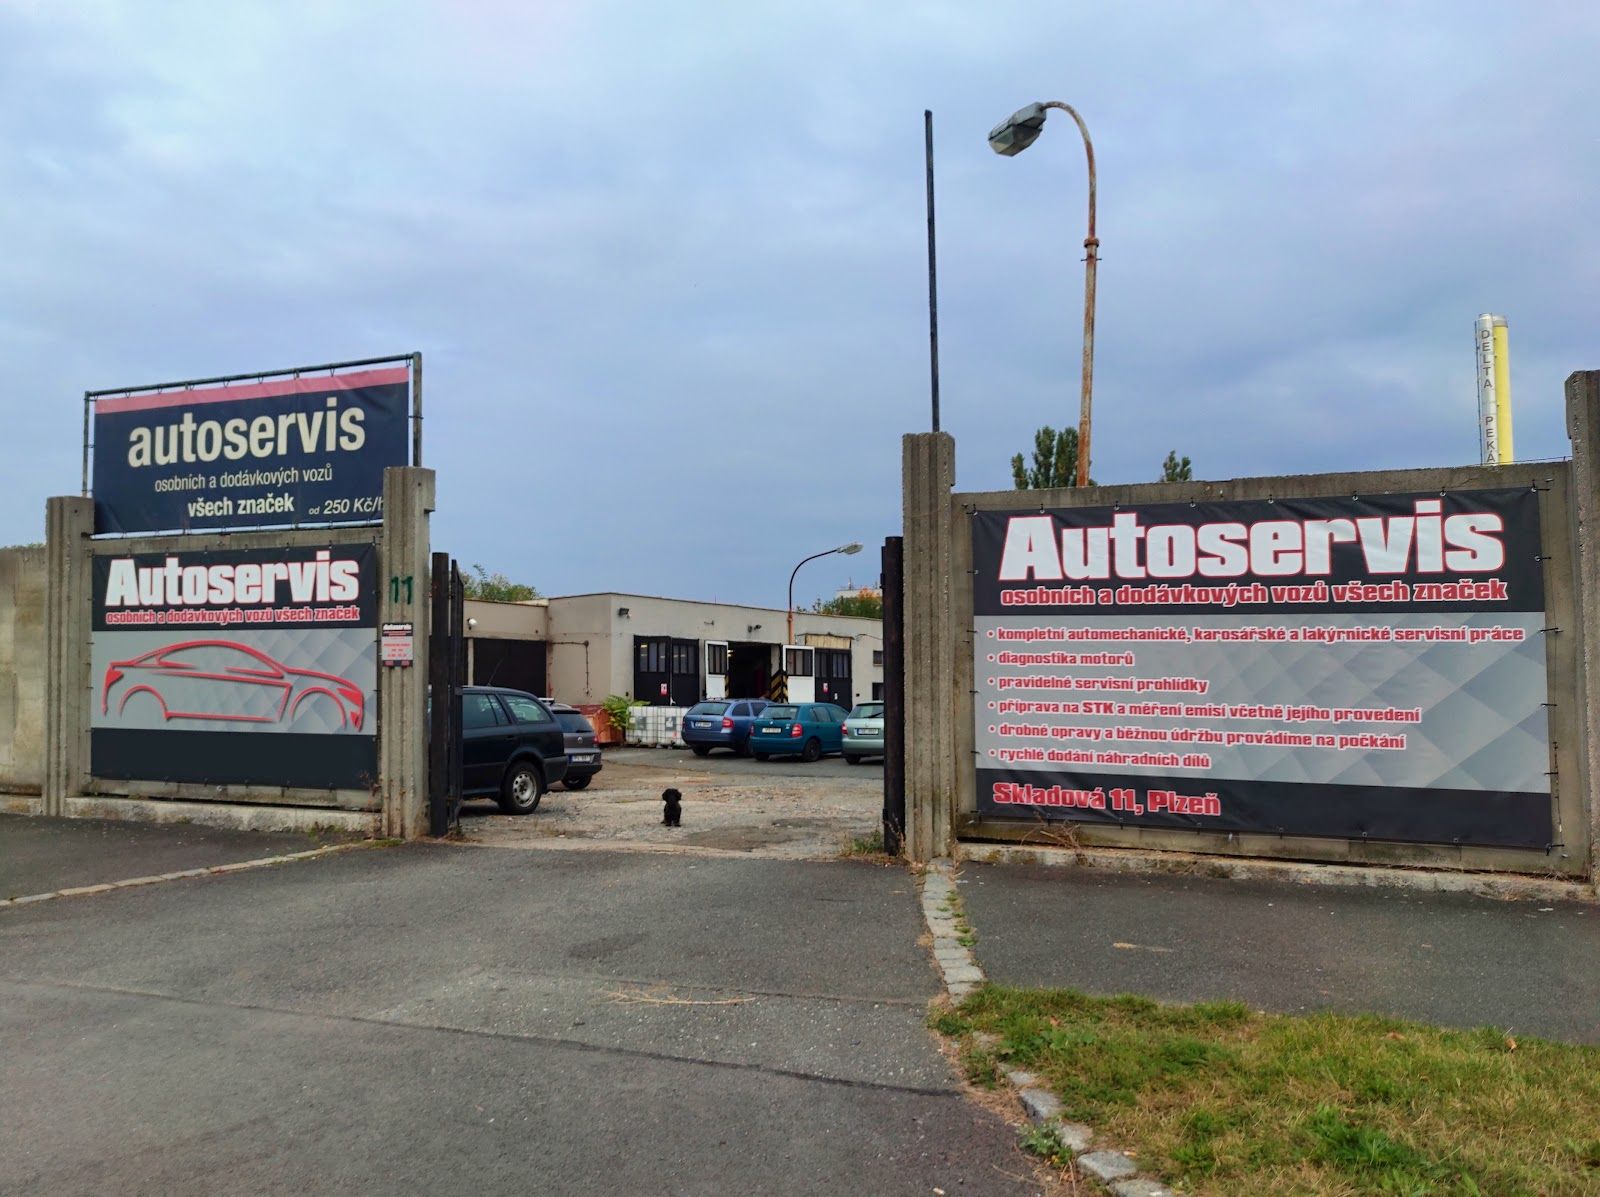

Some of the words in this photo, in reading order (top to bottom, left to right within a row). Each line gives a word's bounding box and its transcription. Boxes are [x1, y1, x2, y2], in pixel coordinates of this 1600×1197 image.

[1480, 329, 1492, 389] DELTA
[128, 397, 365, 468] autoservis
[154, 474, 206, 492] osobních
[209, 476, 217, 489] a
[220, 466, 299, 488] dodávkových
[303, 463, 333, 482] vozů
[187, 497, 233, 518] všech
[237, 492, 295, 514] značek
[309, 506, 321, 515] od
[324, 499, 350, 515] 250
[999, 499, 1506, 581] Autoservis
[105, 550, 360, 607] Autoservis
[391, 576, 413, 605] 11
[1001, 586, 1096, 605] osobních
[1099, 590, 1112, 604] a
[1115, 584, 1268, 607] dodávkových
[1271, 581, 1329, 603] vozů
[1333, 580, 1409, 602] všech
[1413, 579, 1508, 601] značek
[106, 609, 156, 624] osobních
[157, 612, 165, 624] a
[166, 608, 243, 625] dodávkových
[245, 608, 273, 622] vozů
[275, 606, 312, 621] všech
[314, 606, 361, 620] značek
[997, 627, 1065, 642] kompletní
[1067, 628, 1192, 642] automechanické,
[1194, 627, 1286, 641] karosářské
[1289, 629, 1299, 641] a
[1302, 626, 1391, 643] lakýrnické
[1394, 626, 1466, 641] servisní
[1469, 627, 1525, 643] práce
[998, 652, 1077, 666] diagnostika
[1080, 652, 1134, 666] motorů
[998, 676, 1072, 689] pravidelné
[1075, 677, 1134, 690] servisní
[1137, 678, 1208, 693] prohlídky
[999, 700, 1060, 713] příprava
[1063, 704, 1079, 713] na
[1083, 702, 1114, 714] STK
[1117, 704, 1126, 714] a
[1129, 702, 1182, 716] měření
[1185, 704, 1226, 717] emisí
[1230, 705, 1283, 718] včetně
[1286, 706, 1330, 721] jejího
[1333, 709, 1420, 723] provedení
[999, 724, 1048, 737] drobné
[1051, 727, 1101, 741] opravy
[1104, 729, 1114, 739] a
[1116, 727, 1168, 742] běžnou
[1171, 729, 1224, 743] údržbu
[1226, 731, 1312, 746] provádíme
[1316, 736, 1336, 746] na
[1339, 735, 1405, 749] počkání
[1000, 748, 1045, 761] rychlé
[1047, 750, 1094, 763] dodání
[1096, 752, 1180, 766] náhradních
[1183, 754, 1211, 767] dílů
[993, 782, 1106, 808] Skladová
[1109, 789, 1144, 814] 11,
[1147, 790, 1222, 814] Plzeň
